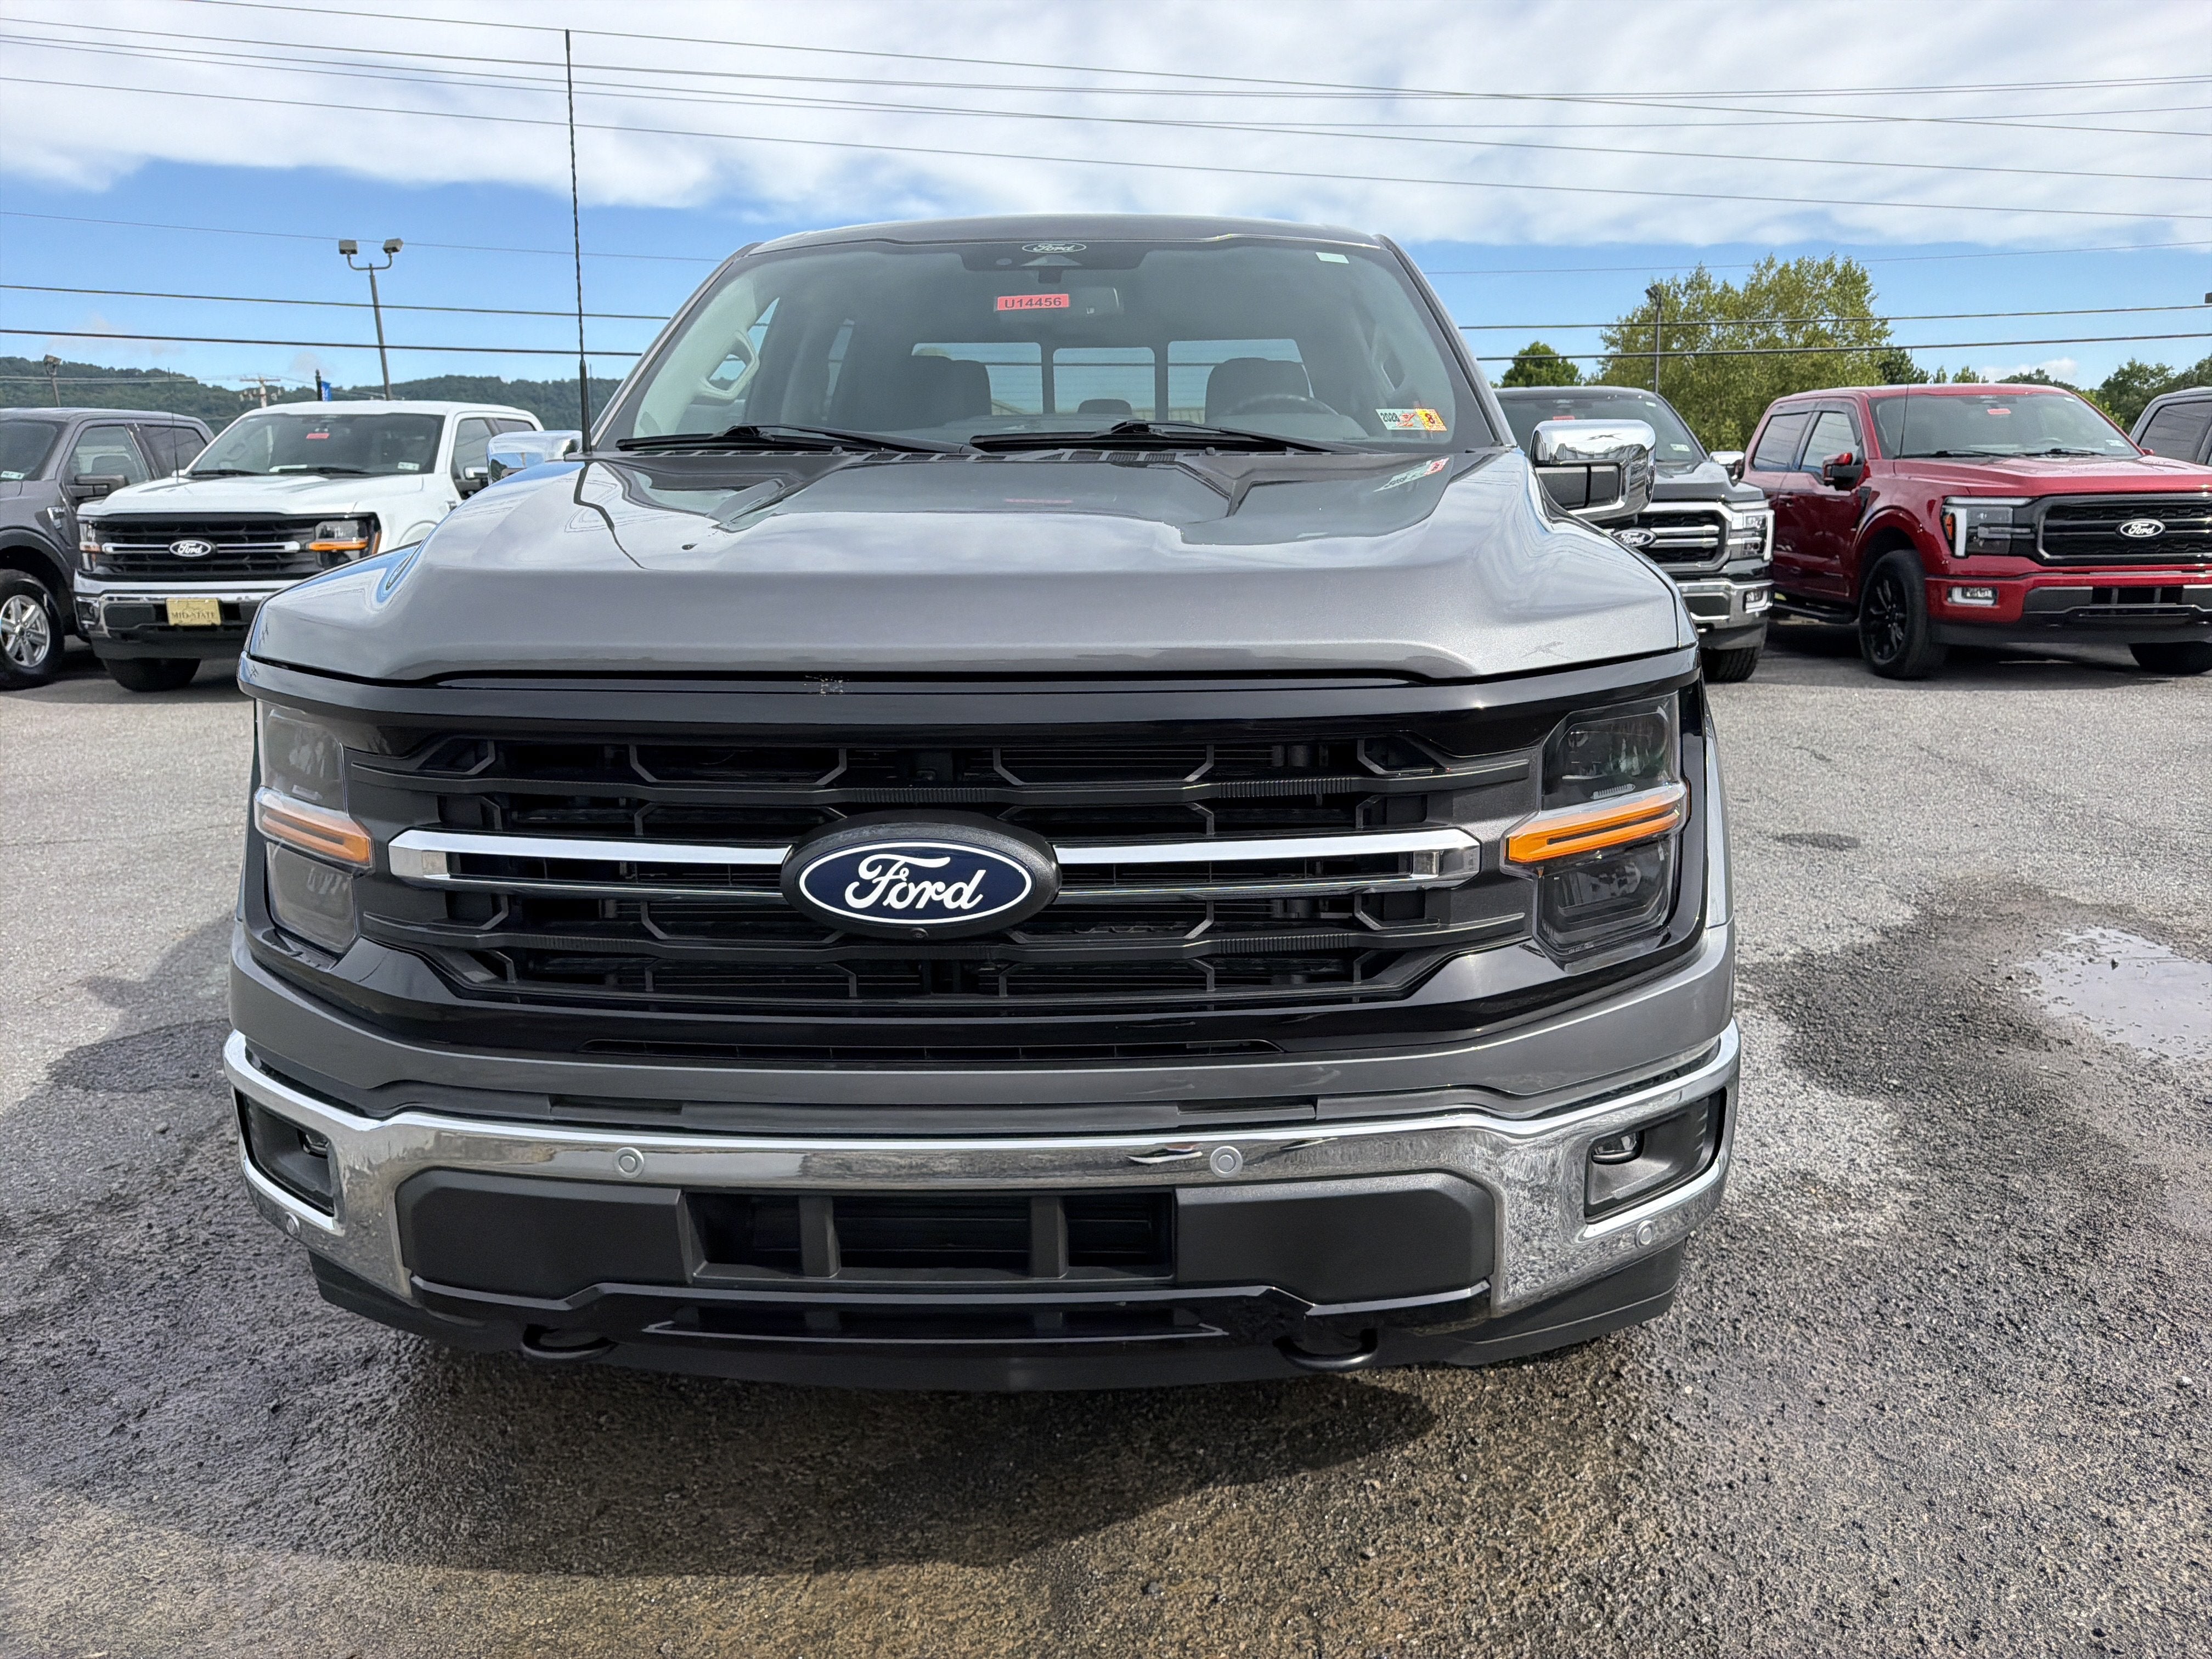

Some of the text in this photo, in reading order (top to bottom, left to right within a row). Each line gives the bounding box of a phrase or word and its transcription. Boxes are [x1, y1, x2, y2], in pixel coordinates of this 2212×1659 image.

[1005, 297, 1062, 308] U14456
[2128, 523, 2155, 534] Ford
[177, 542, 203, 554] Ford
[845, 854, 986, 909] Ford
